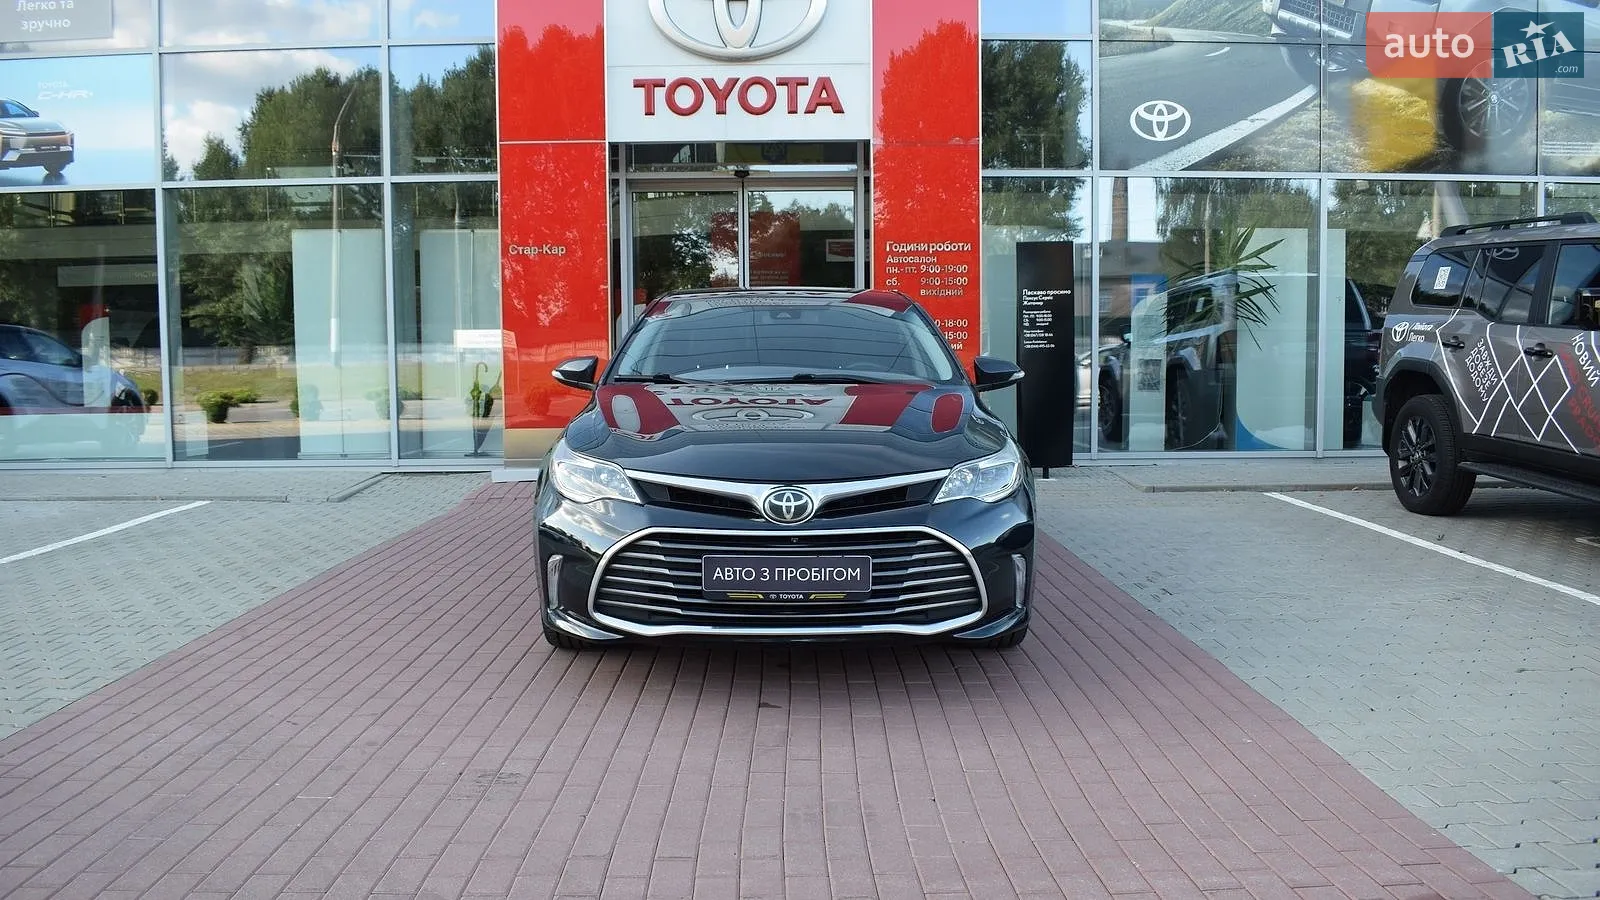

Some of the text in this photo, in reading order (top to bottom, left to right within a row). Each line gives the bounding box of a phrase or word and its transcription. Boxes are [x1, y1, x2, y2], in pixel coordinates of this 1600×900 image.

[16, 0, 74, 12] Легко та
[21, 18, 71, 32] зручно
[633, 76, 845, 117] TOYOTA
[508, 243, 566, 257] Стар-Кар
[886, 240, 972, 254] Години роботи
[886, 254, 937, 264] Автосалон
[886, 277, 901, 286] сб.
[920, 287, 963, 297] вихідний
[1477, 338, 1498, 386] ЗАВЖДИ
[1571, 332, 1600, 387] НОВИЙ
[1470, 347, 1491, 390] ДОВЕЗЕ
[1464, 357, 1489, 402] ДОДОМУ
[713, 567, 756, 581] АВТО
[775, 567, 861, 581] ПРОБІГОМ
